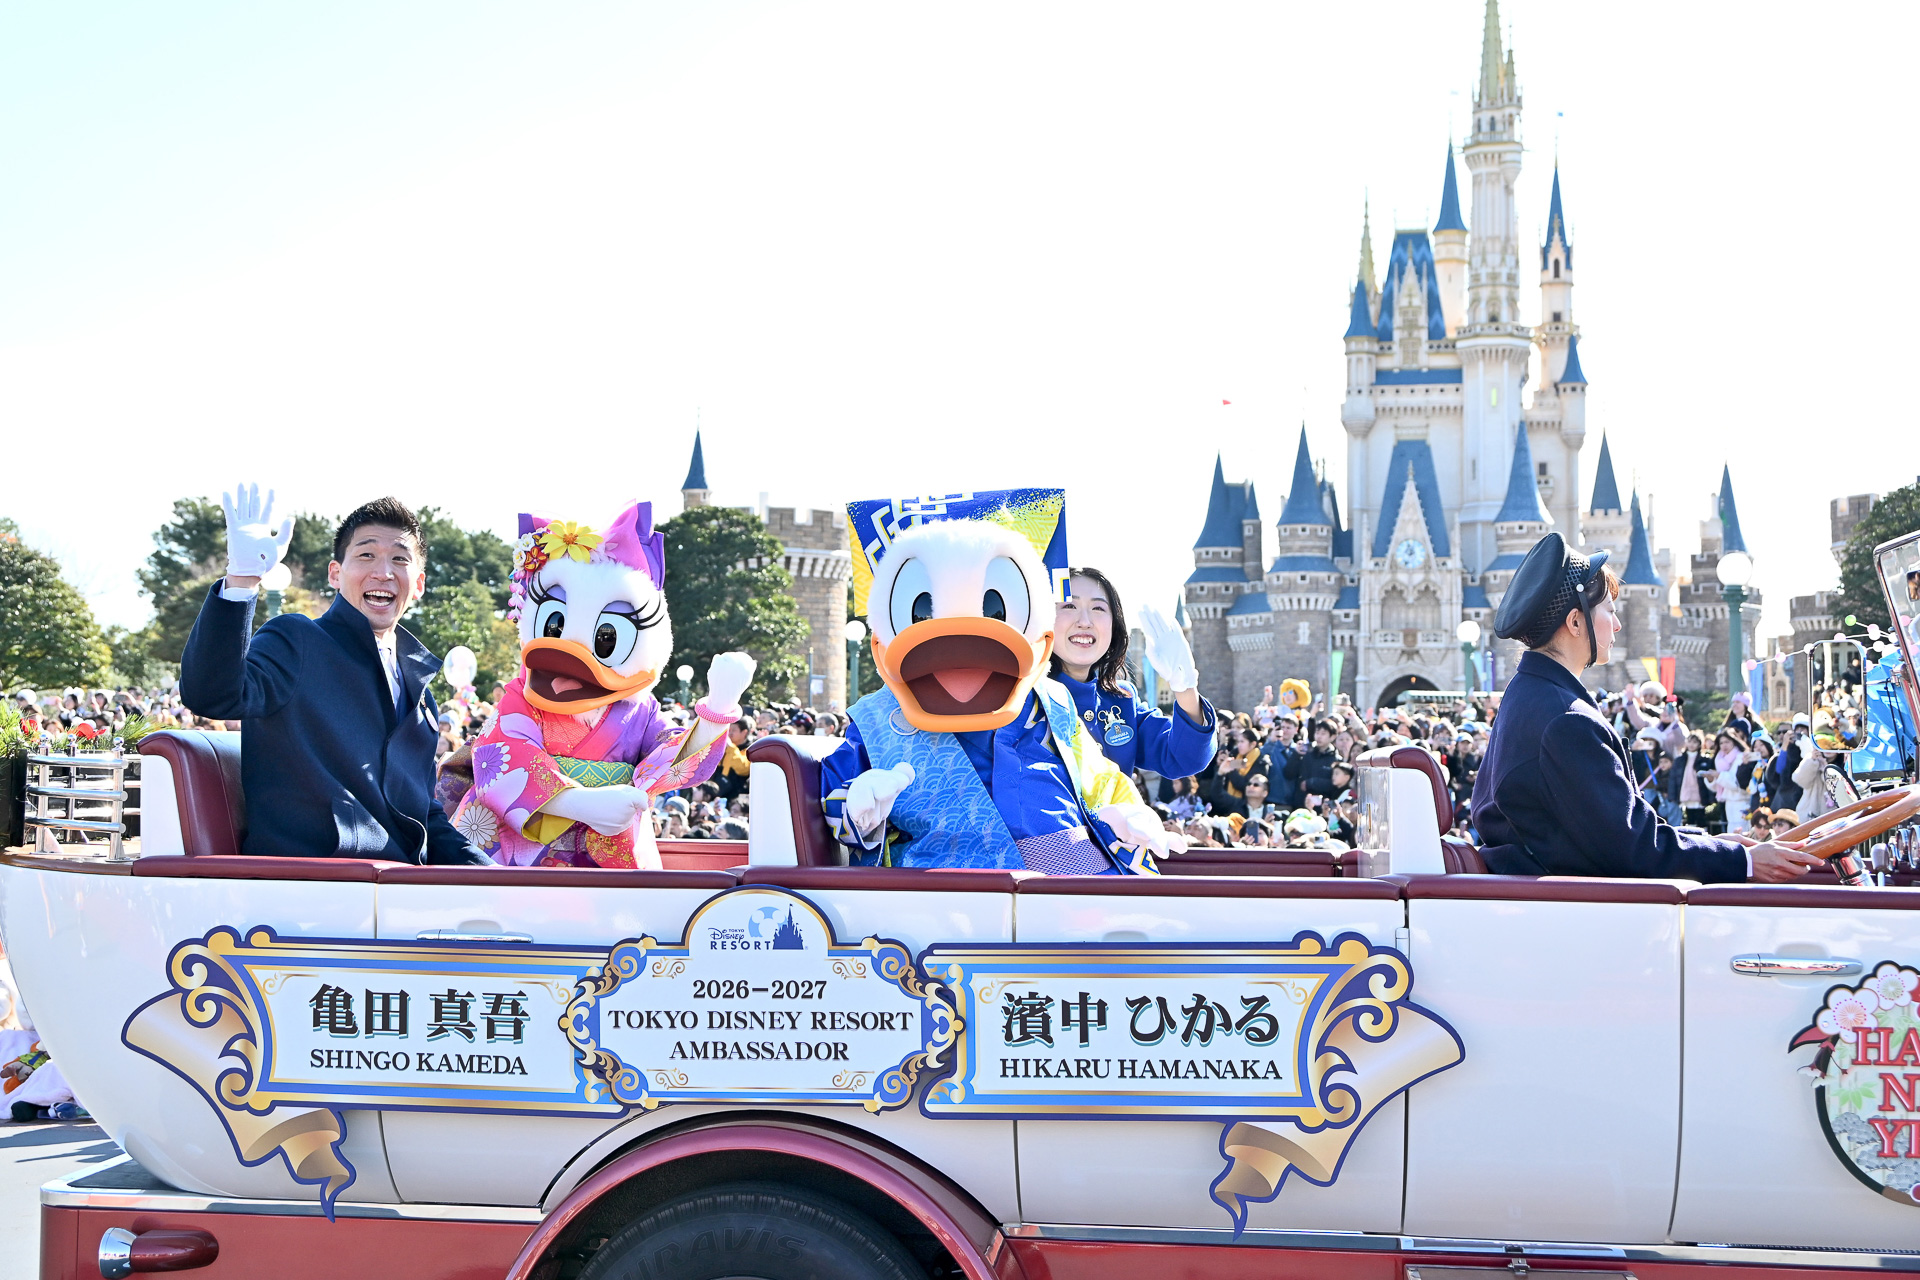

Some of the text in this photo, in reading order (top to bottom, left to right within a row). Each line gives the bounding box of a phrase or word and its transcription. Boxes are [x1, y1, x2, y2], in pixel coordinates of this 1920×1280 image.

[710, 940, 771, 950] RESORT
[308, 983, 531, 1044] 亀田 真吾
[607, 1010, 914, 1031] TOKYO DISNEY RESORT
[1001, 991, 1280, 1048] 濱中 ひかる
[668, 1040, 850, 1062] AMBASSADOR
[310, 1049, 529, 1076] SHINGO KAMEDA
[999, 1058, 1283, 1080] HIKARU HAMANAKA
